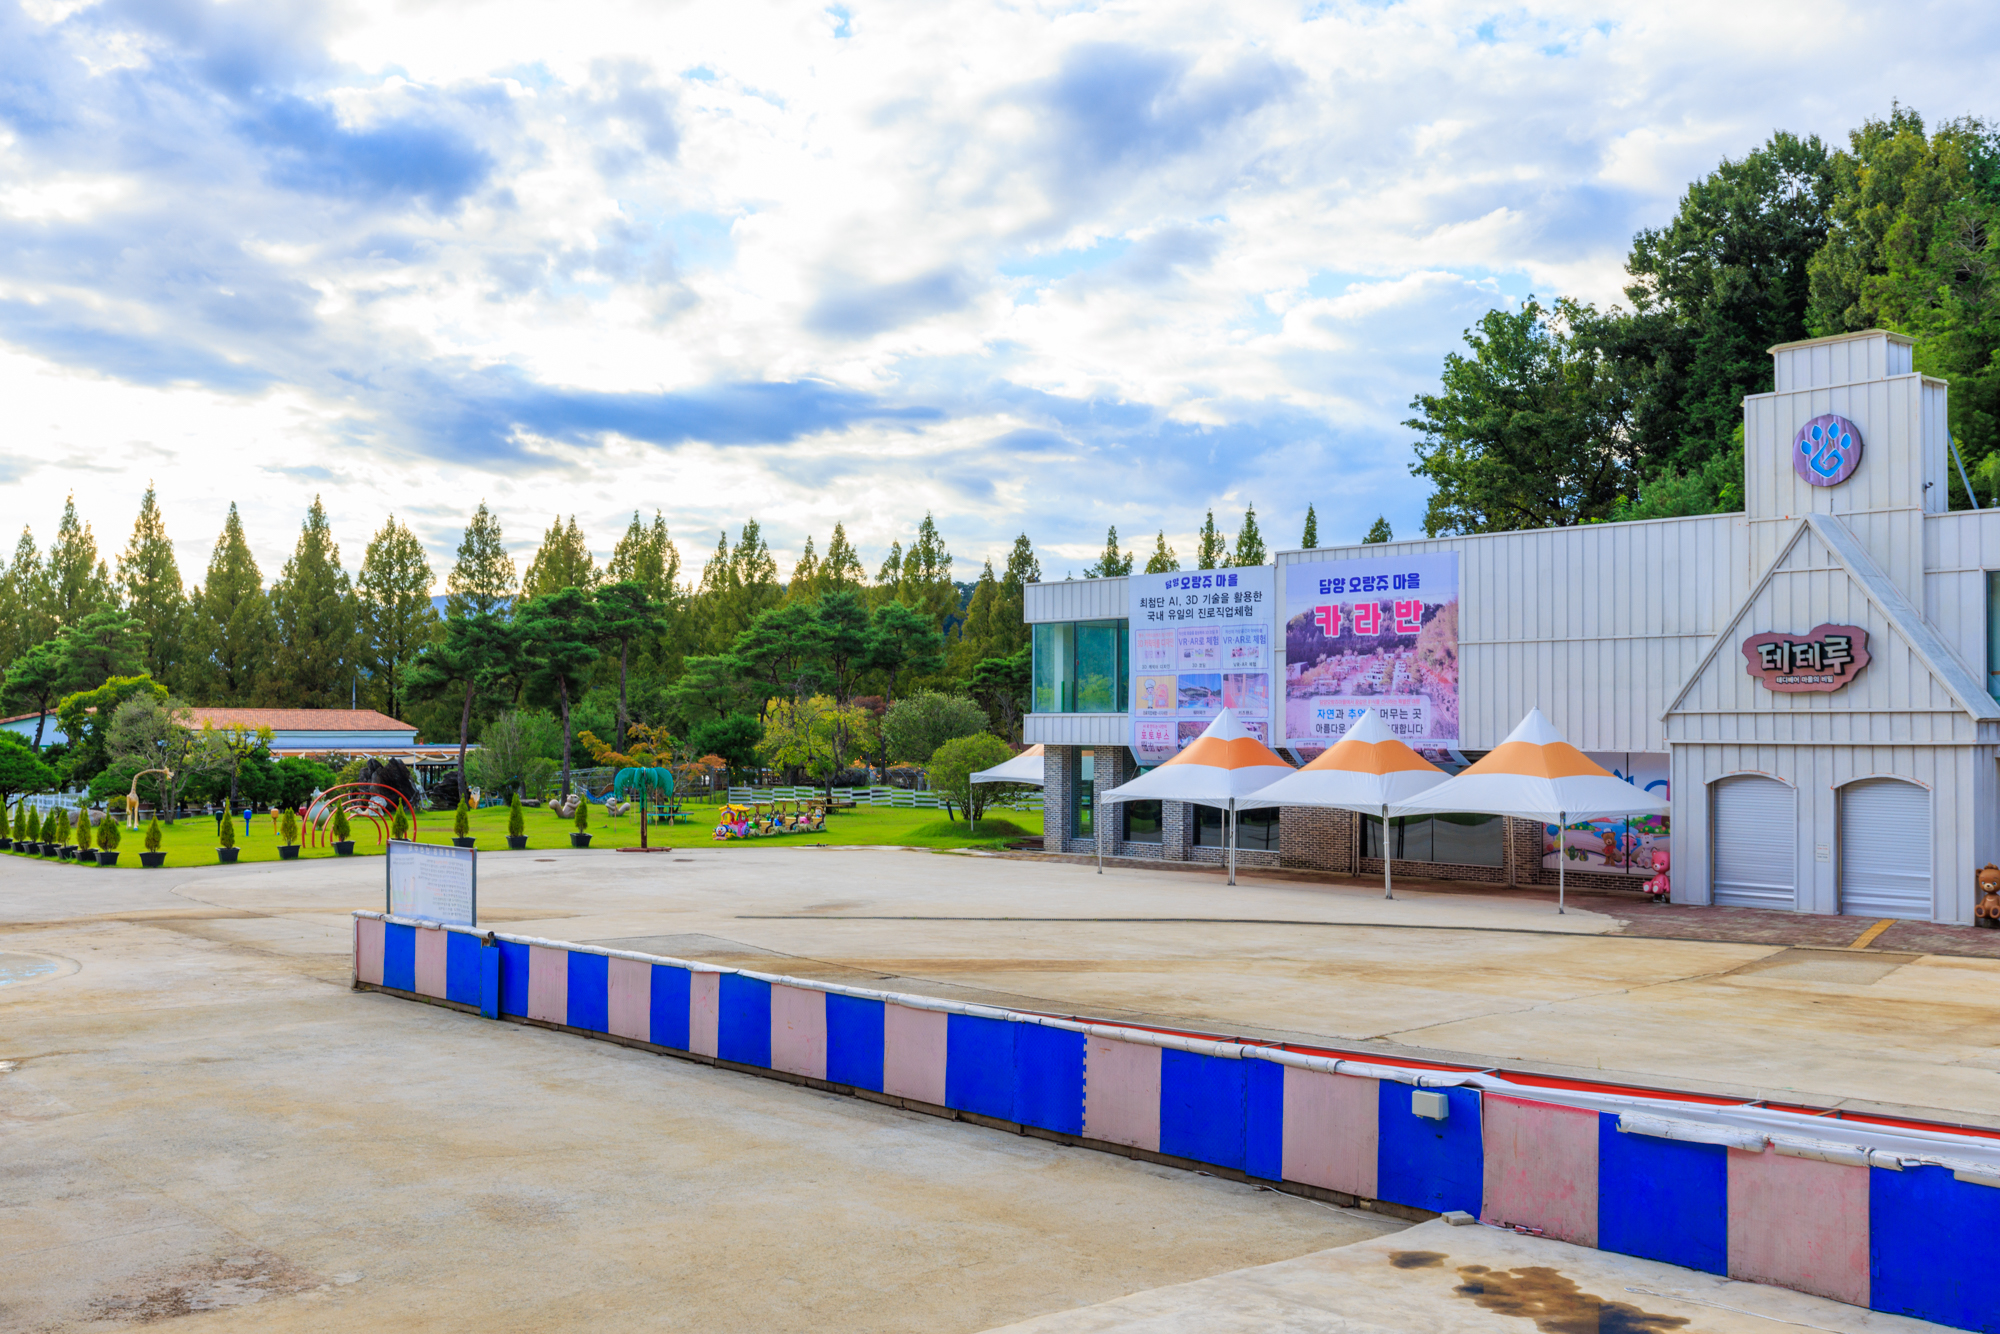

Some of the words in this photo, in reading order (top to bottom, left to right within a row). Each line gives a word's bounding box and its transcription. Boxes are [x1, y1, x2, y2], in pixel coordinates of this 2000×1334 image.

[1180, 575, 1212, 590] 오랑쥬
[1215, 573, 1238, 588] 마을
[1319, 578, 1346, 595] 담양
[1348, 575, 1389, 593] 오랑쥬
[1392, 572, 1421, 590] 마을
[1140, 597, 1165, 609] 최첨단
[1185, 594, 1198, 606] 3D
[1202, 592, 1230, 605] 기술을
[1233, 590, 1263, 604] 활용한
[1147, 610, 1165, 622] 국내
[1168, 608, 1195, 621] 유일의
[1197, 605, 1253, 619] 진로직업체험
[1314, 599, 1425, 638] 카라반
[1205, 634, 1220, 646] 체험
[1252, 633, 1267, 645] 체험
[1757, 635, 1855, 675] 테테루
[1775, 675, 1800, 685] 테디베어
[1316, 708, 1344, 720] 자연과
[1347, 708, 1367, 720] 추억
[1380, 708, 1408, 720] 머무는
[1412, 708, 1422, 720] 곳
[1141, 728, 1170, 741] 포토부스
[1315, 723, 1346, 735] 아름다운
[1387, 724, 1424, 735] 대합니다
